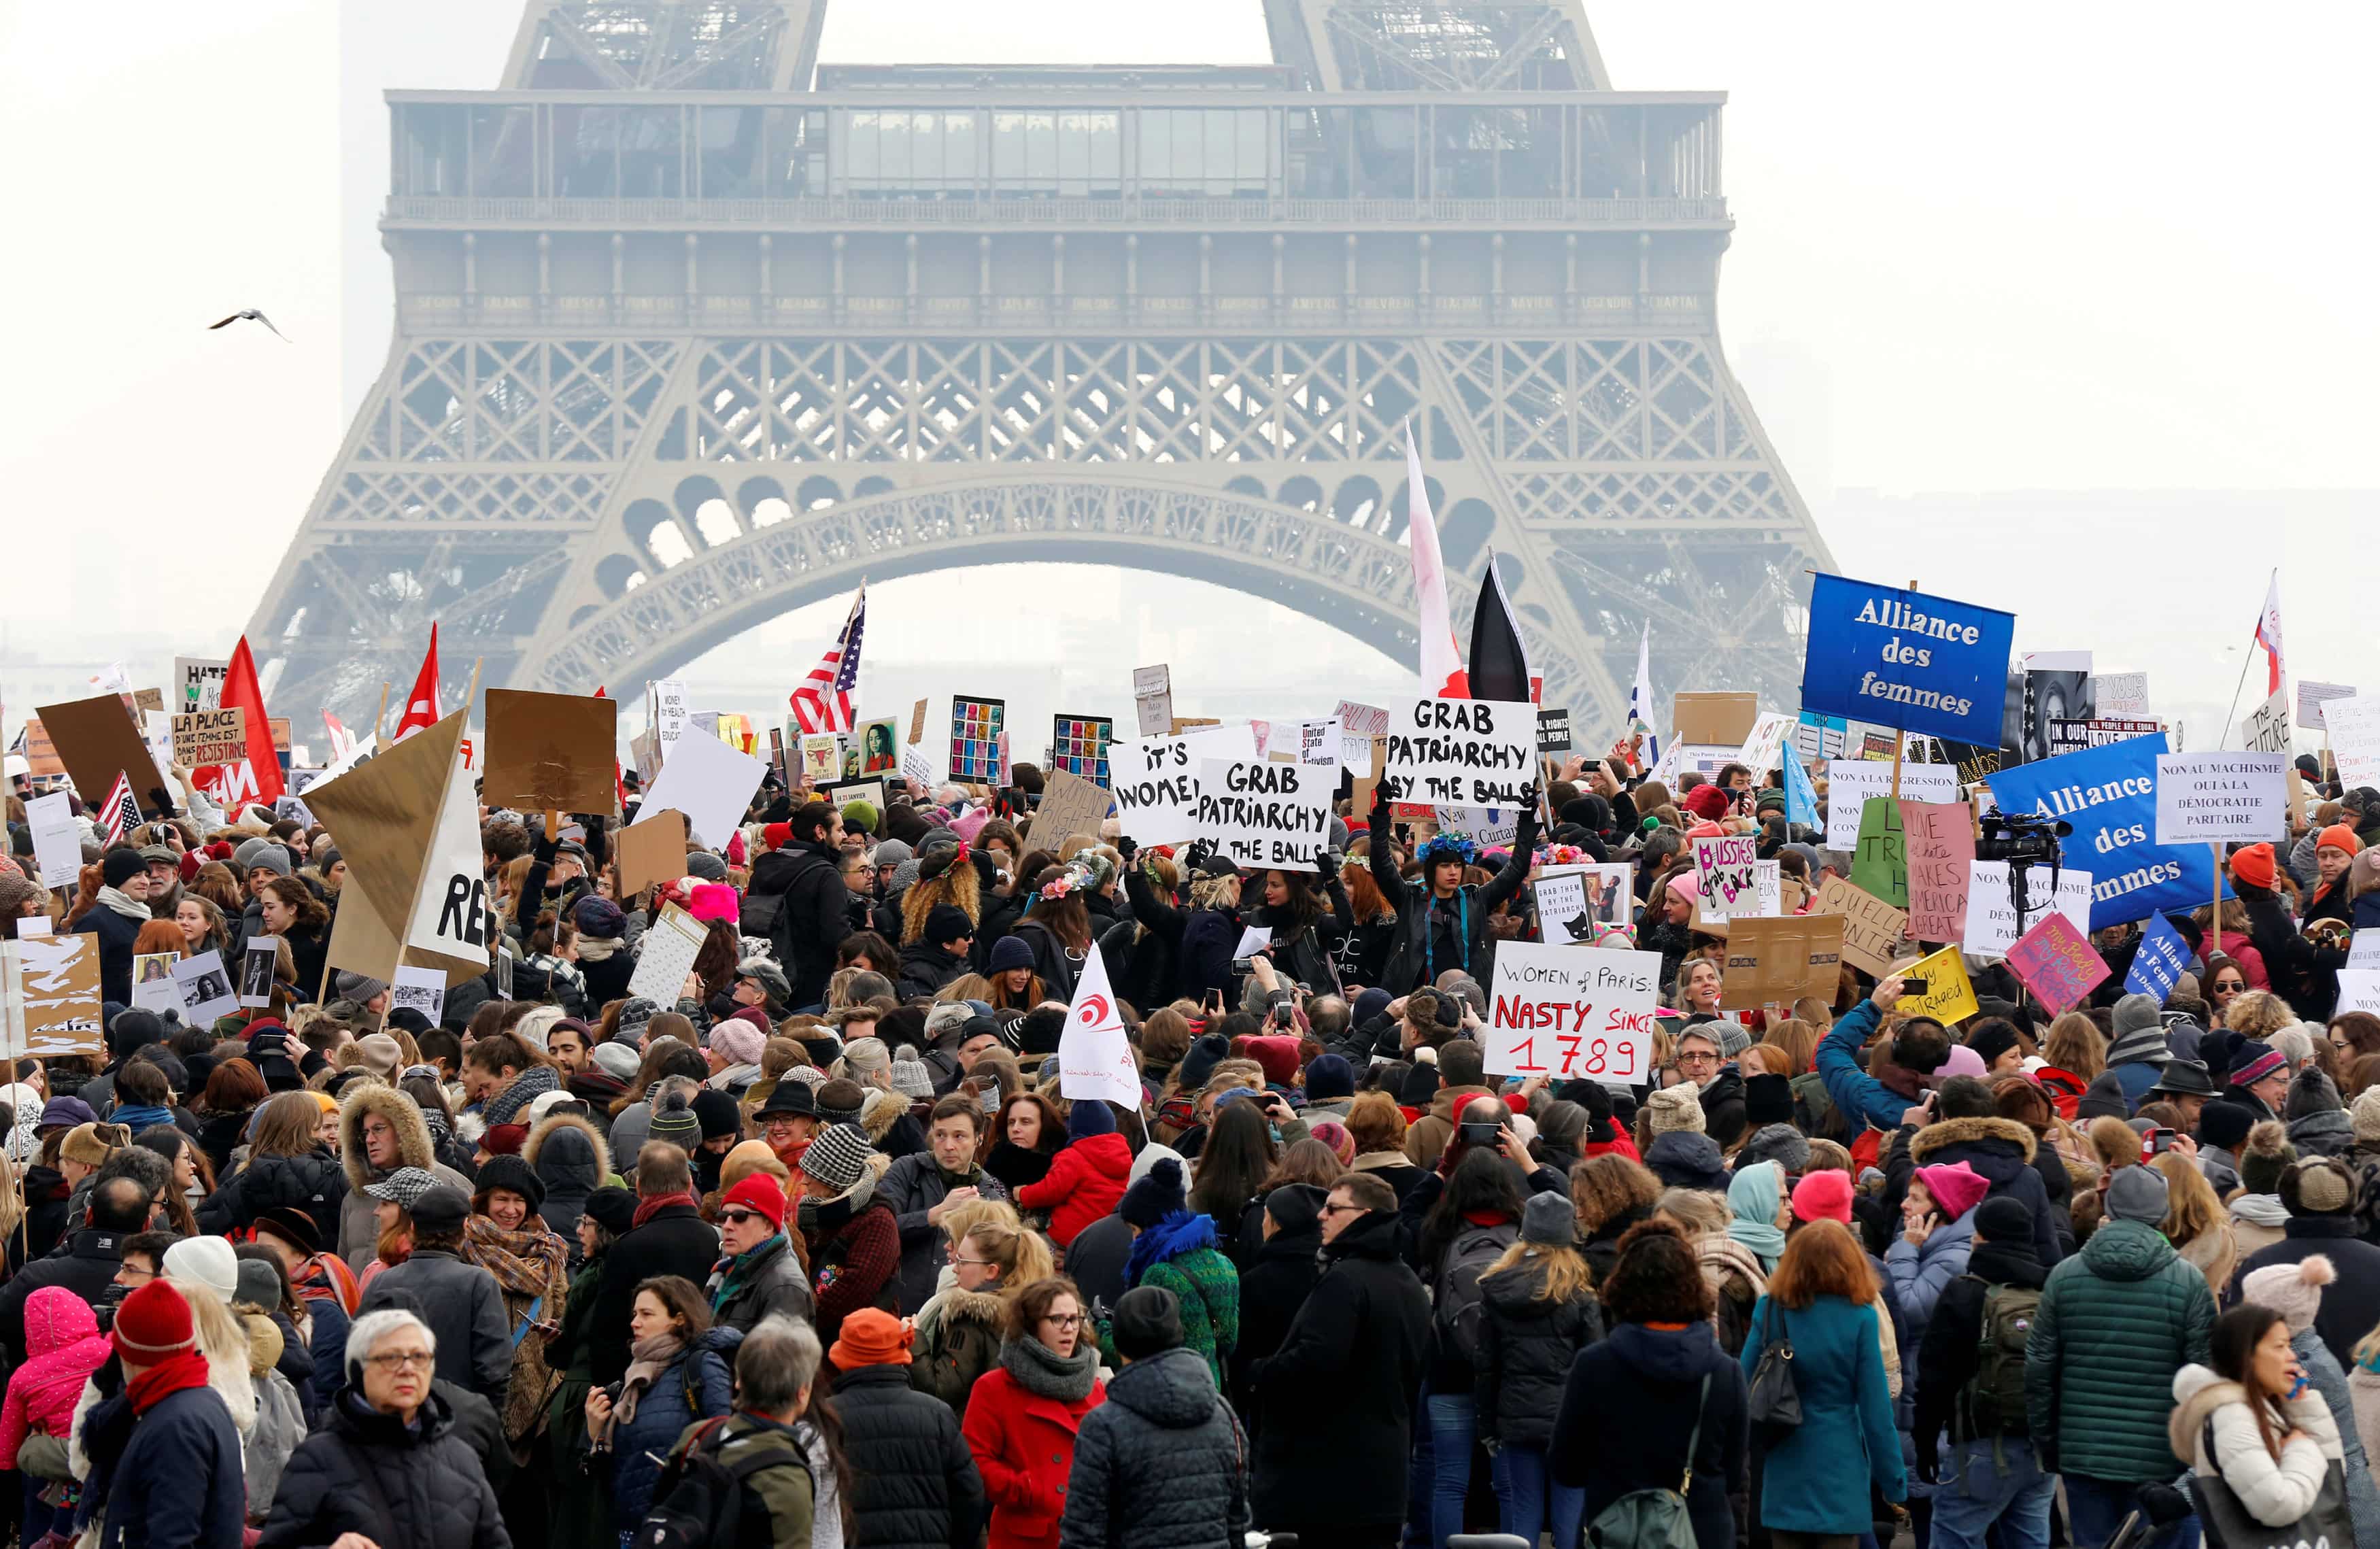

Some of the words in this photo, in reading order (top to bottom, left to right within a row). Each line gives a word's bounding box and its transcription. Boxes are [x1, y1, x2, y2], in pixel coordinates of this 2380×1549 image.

[1855, 598, 1979, 645] Alliance
[1882, 637, 1931, 667] des
[1858, 671, 1973, 717] femmes
[175, 714, 191, 732] LA
[196, 711, 235, 730] PLACE
[1415, 700, 1494, 734] GRAB
[1546, 718, 1568, 730] RIGHTS
[1814, 713, 1828, 728] HER
[1302, 727, 1325, 738] United
[2052, 724, 2062, 740] IN
[2067, 724, 2087, 741] OUR
[2137, 723, 2154, 732] EQUAL
[197, 732, 221, 743] FEMME
[224, 729, 238, 739] EST
[1302, 738, 1322, 747] State
[1548, 731, 1569, 742] PEOPLE
[177, 747, 195, 756] DANS
[182, 755, 192, 766] LA
[2162, 765, 2188, 775] NON
[2190, 765, 2206, 774] AU
[2210, 763, 2282, 773] MACHISME
[1227, 763, 1299, 794] GRAB
[1833, 772, 1856, 781] NON
[1870, 774, 1883, 783] LA
[1886, 774, 1953, 787] RGRESSION
[2194, 781, 2216, 791] OUI
[2232, 781, 2249, 789] LA
[849, 792, 866, 800] JANVIER
[1390, 776, 1414, 800] BY
[1425, 777, 1463, 802] THE
[1474, 779, 1535, 808] BALLS
[1885, 792, 1924, 801] DOITS
[2036, 776, 2153, 820] Alliance
[2178, 796, 2262, 808] DÉMOCRATIE
[1837, 806, 1860, 815] NON
[2187, 814, 2253, 825] PARITAIRE
[2095, 823, 2147, 853] des
[1197, 838, 1219, 860] BY
[1230, 839, 1263, 860] THE
[1272, 840, 1323, 864] BALLS
[1975, 873, 2001, 885] NON
[2028, 879, 2087, 895] ACISME
[2090, 860, 2181, 904] mmes
[1538, 887, 1557, 896] GRAB
[1561, 884, 1580, 893] THEM
[1911, 890, 1968, 913] MERICA
[1540, 904, 1584, 917] PATRIARCHY
[1914, 915, 1956, 936] GREAT
[1503, 961, 1570, 985] WOMEN
[1578, 971, 1591, 993] of
[1495, 994, 1592, 1032] NASTY
[1509, 1035, 1634, 1076] 1789
